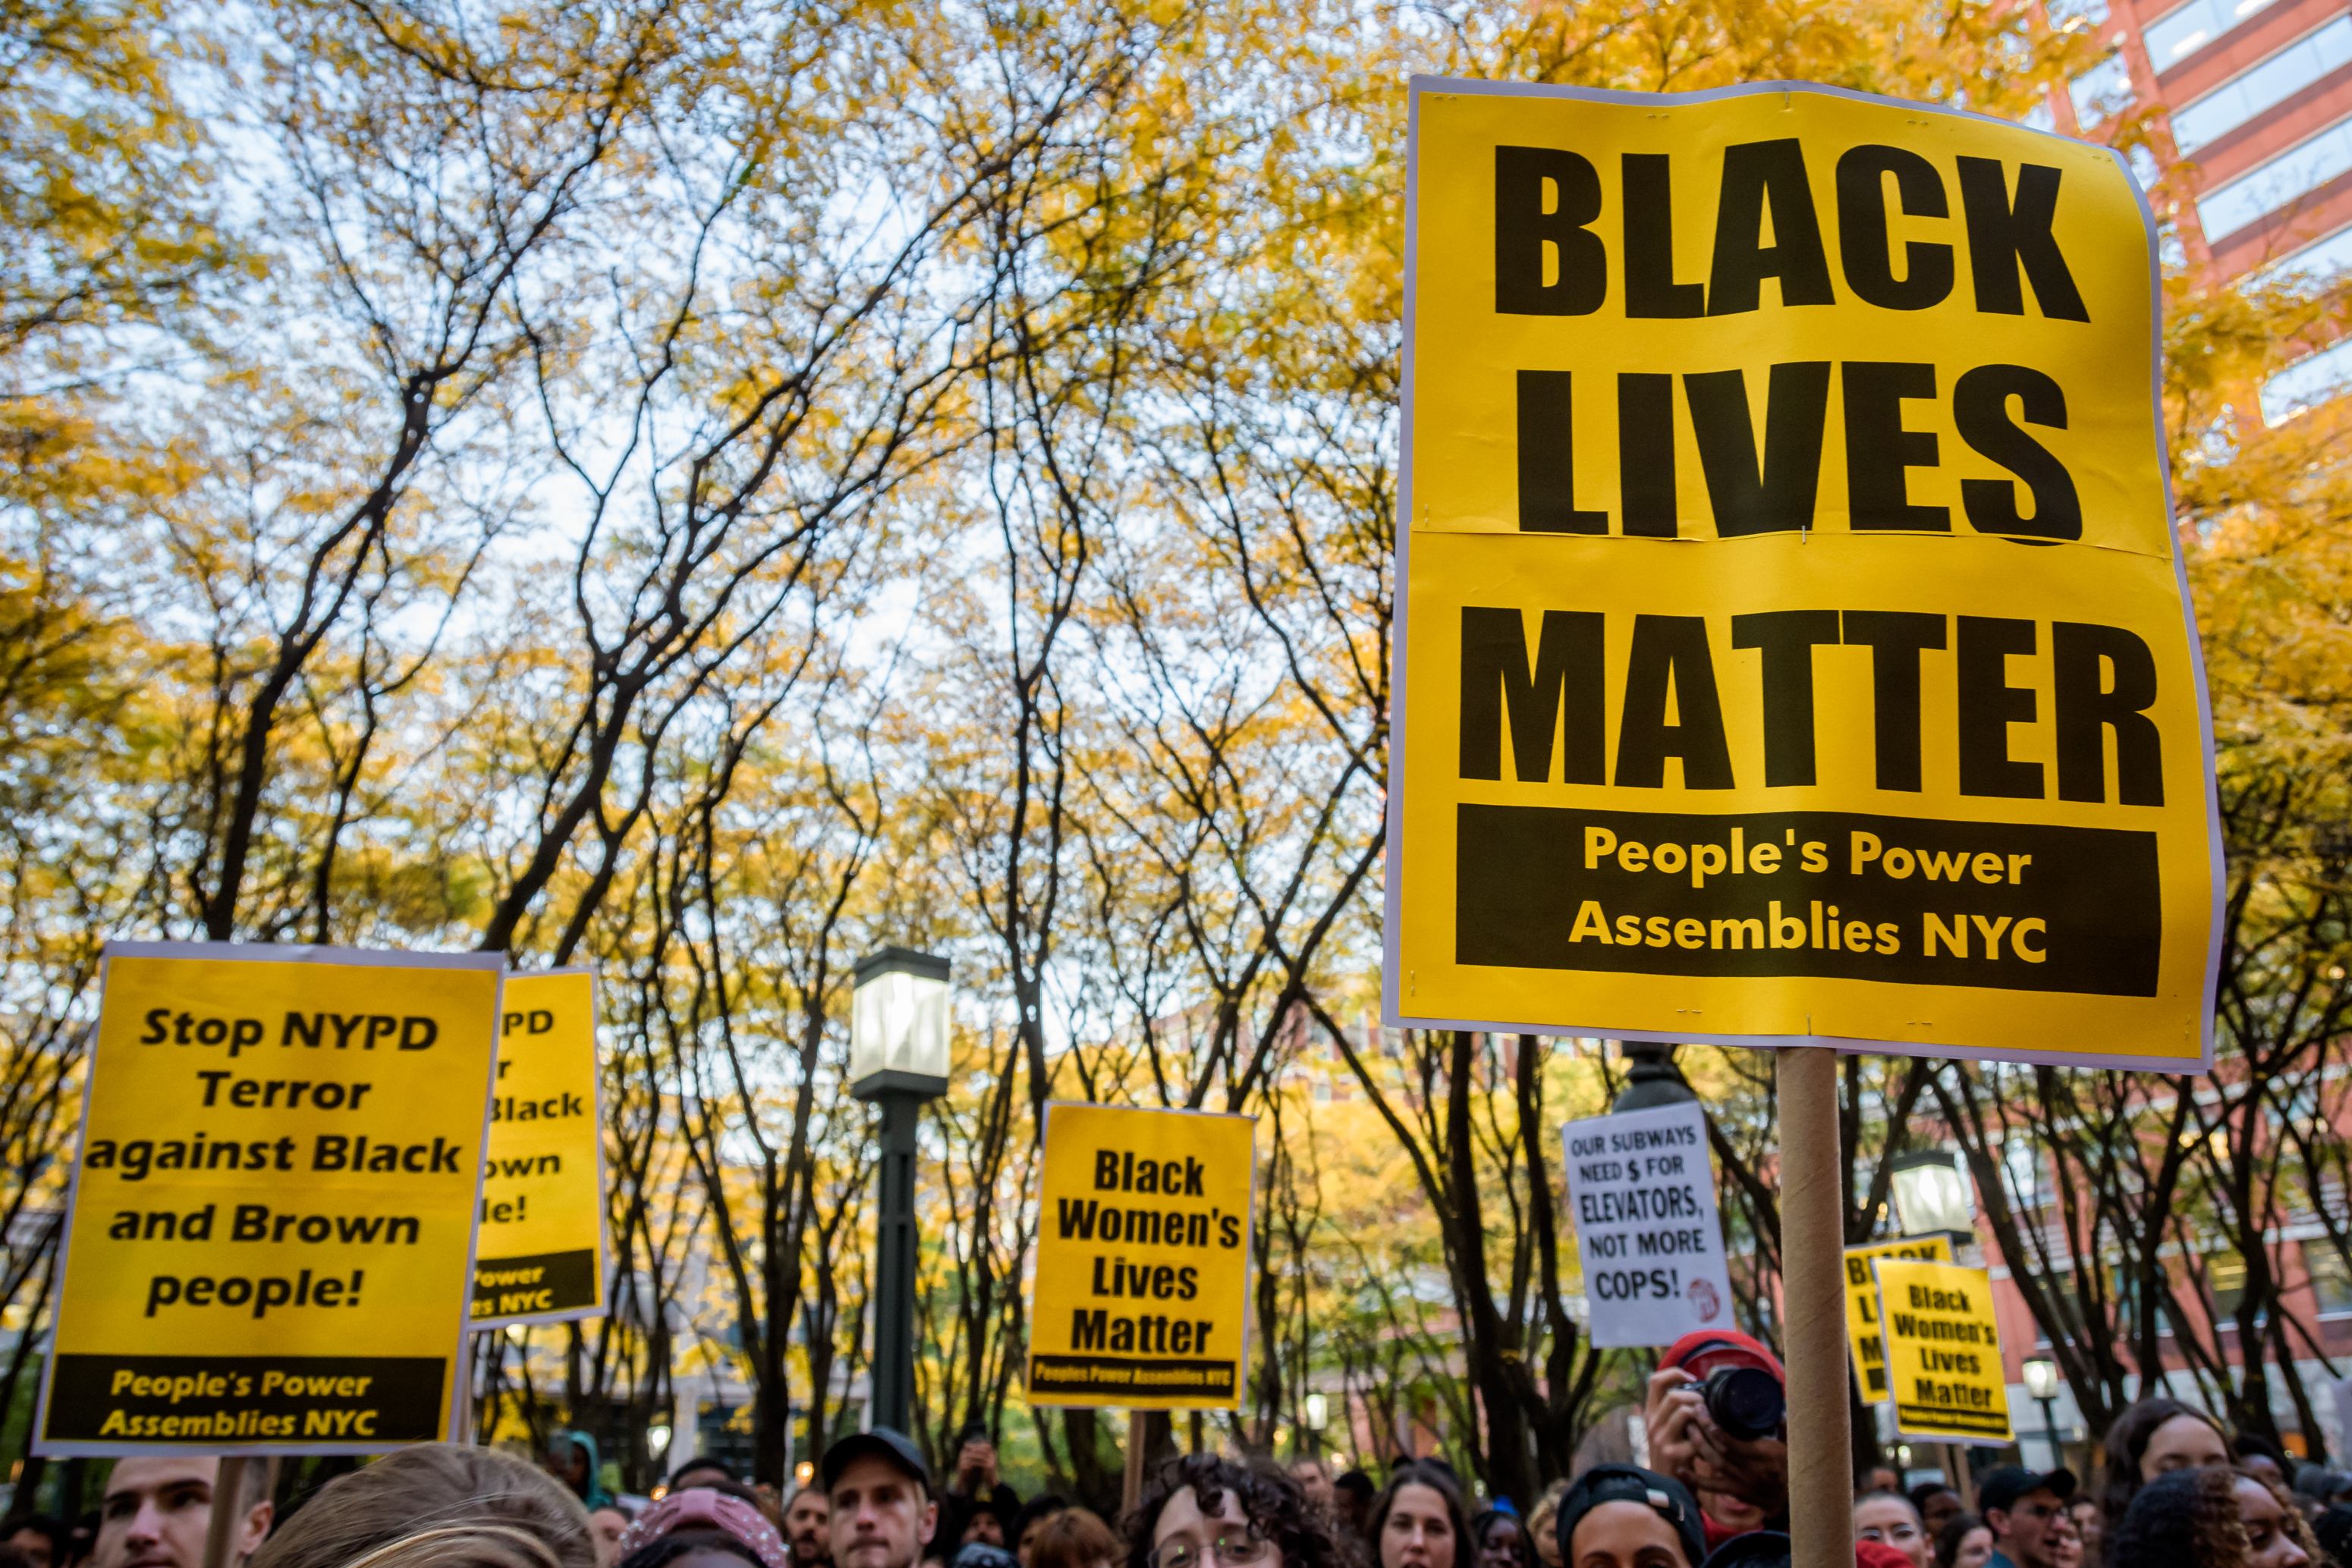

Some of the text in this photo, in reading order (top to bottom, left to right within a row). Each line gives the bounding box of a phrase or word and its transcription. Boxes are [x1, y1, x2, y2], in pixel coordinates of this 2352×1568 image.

[1495, 138, 2090, 323] BLACK
[1517, 361, 2083, 546] LIVES
[1460, 606, 2165, 807] MATTER
[1584, 826, 2031, 888] People's Power
[1568, 900, 2047, 963] Assemblies NYC
[140, 1009, 438, 1058] Stop NYPD
[503, 1010, 553, 1036] PD
[197, 1071, 372, 1110] Terror
[86, 1133, 462, 1181] against Black
[1571, 1125, 1696, 1157] OUR SUBWAYS
[484, 1155, 561, 1179] own
[1095, 1150, 1205, 1196] Black
[1580, 1156, 1684, 1184] NEED $ FOR
[109, 1204, 419, 1244] and Brown
[1058, 1199, 1240, 1249] Women's
[1580, 1184, 1704, 1225] ELEVATORS,
[1589, 1228, 1706, 1258] NOT MORE
[145, 1269, 364, 1318] people!
[1093, 1256, 1198, 1301] Lives
[1596, 1268, 1680, 1300] COPS!
[1909, 1284, 1973, 1312] Black
[499, 1288, 553, 1314] NYC
[1071, 1309, 1213, 1354] Matter
[1894, 1313, 1997, 1346] Women's
[1920, 1348, 1980, 1375] Lives
[111, 1370, 373, 1403] People's Power
[1915, 1378, 1992, 1406] Matter
[99, 1409, 378, 1436] Assemblies NYC
